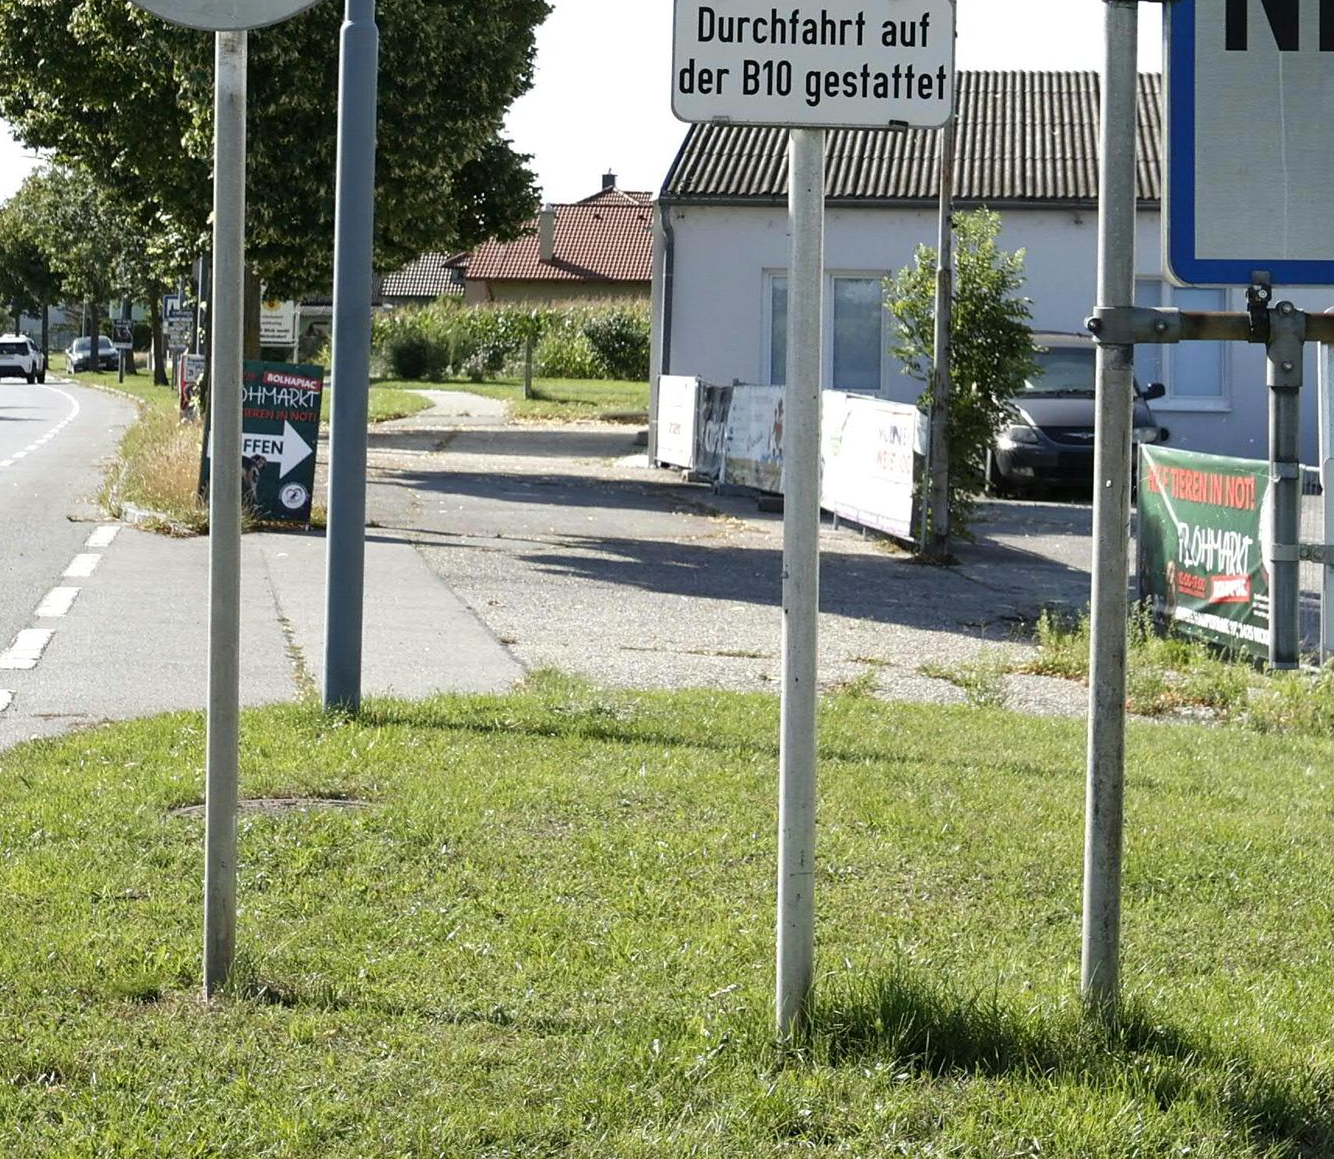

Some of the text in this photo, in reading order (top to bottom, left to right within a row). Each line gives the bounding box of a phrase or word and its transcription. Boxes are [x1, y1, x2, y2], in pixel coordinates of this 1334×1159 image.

[697, 6, 931, 48] Durchfahrt auf
[679, 58, 947, 107] der B10 gestattet
[242, 384, 320, 408] HMARKT
[267, 372, 317, 389] BOLHAPIAC
[242, 408, 274, 419] IEREN
[276, 409, 289, 421] IN
[243, 438, 284, 455] FFEN
[1170, 467, 1208, 503] TIEREN
[1209, 473, 1223, 506] IN
[1225, 473, 1256, 511] NOT!
[1178, 521, 1254, 576] FLOHMARKT
